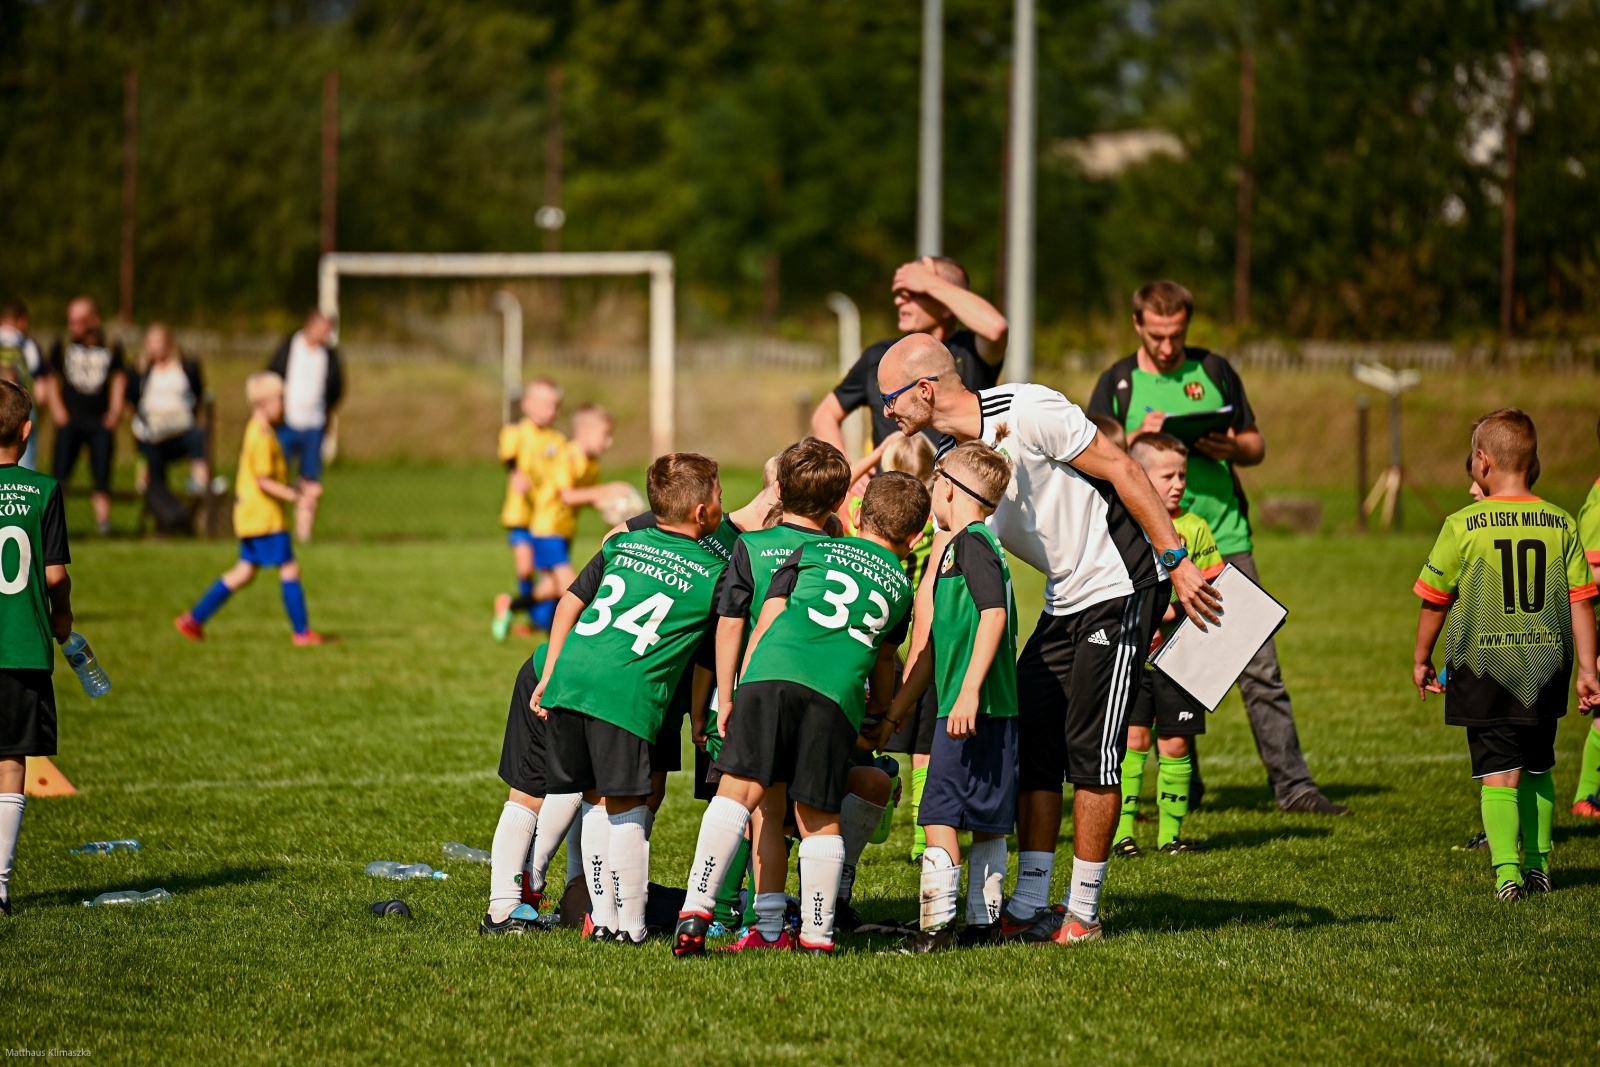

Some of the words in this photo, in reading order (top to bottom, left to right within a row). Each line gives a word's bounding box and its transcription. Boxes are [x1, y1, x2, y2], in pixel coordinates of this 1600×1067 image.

[1466, 512, 1488, 531] UKS
[1490, 511, 1519, 527] LISEK
[613, 554, 694, 594] TWORKÓW
[616, 541, 660, 556] AKADEMIA
[660, 549, 710, 578] PIŁKARSKA
[816, 542, 870, 559] AKADEMIA
[871, 554, 911, 588] PIŁKARSK
[824, 553, 902, 603] TWORKÓW
[831, 547, 879, 570] MŁODEGO
[1493, 538, 1547, 615] 10
[574, 574, 675, 657] 34
